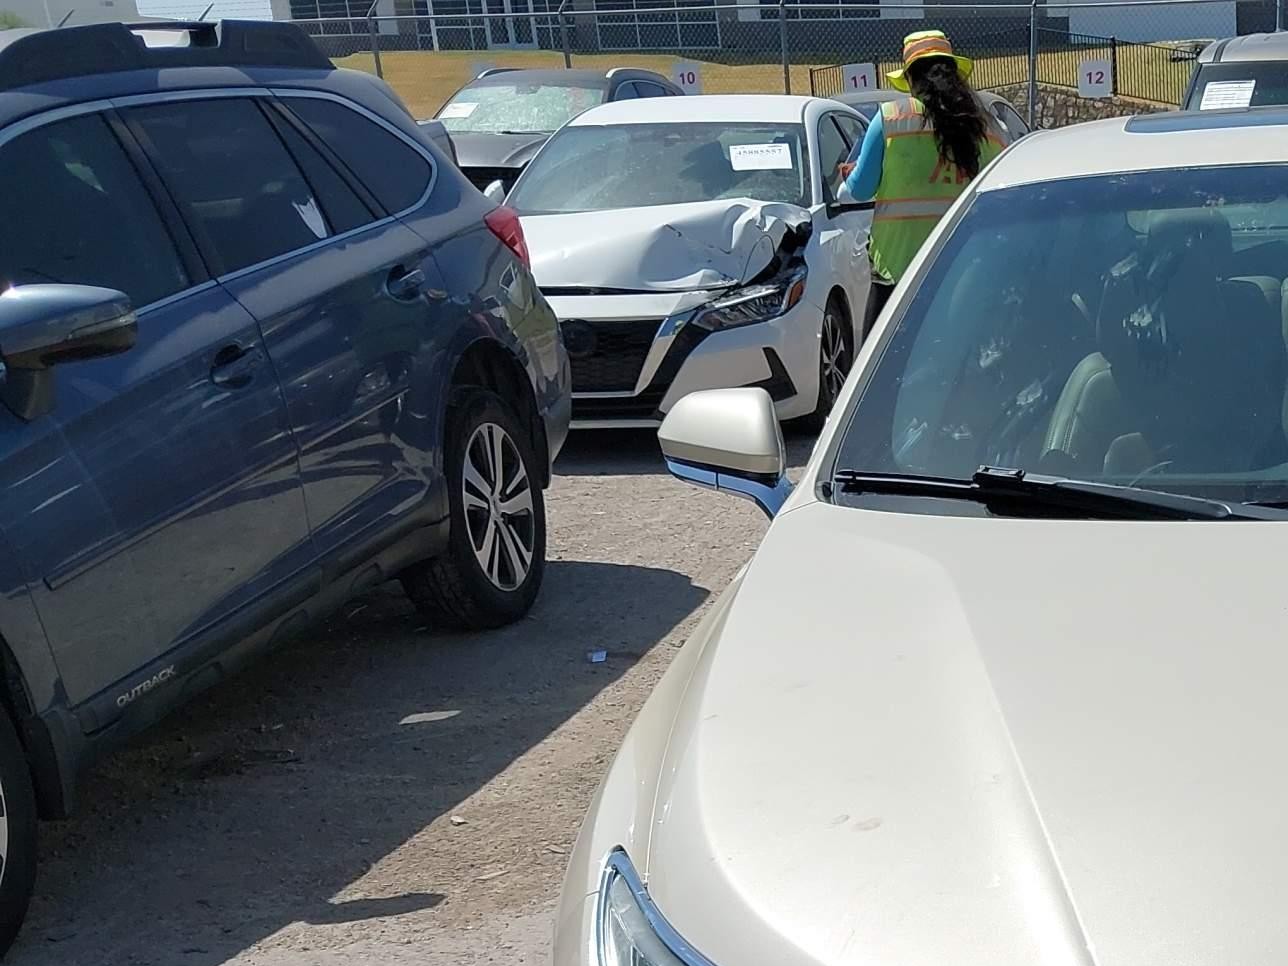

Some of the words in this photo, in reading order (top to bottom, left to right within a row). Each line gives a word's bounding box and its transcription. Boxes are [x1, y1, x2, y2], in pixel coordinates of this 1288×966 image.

[679, 72, 696, 85] 10
[850, 75, 868, 88] 11
[1086, 71, 1105, 85] 12
